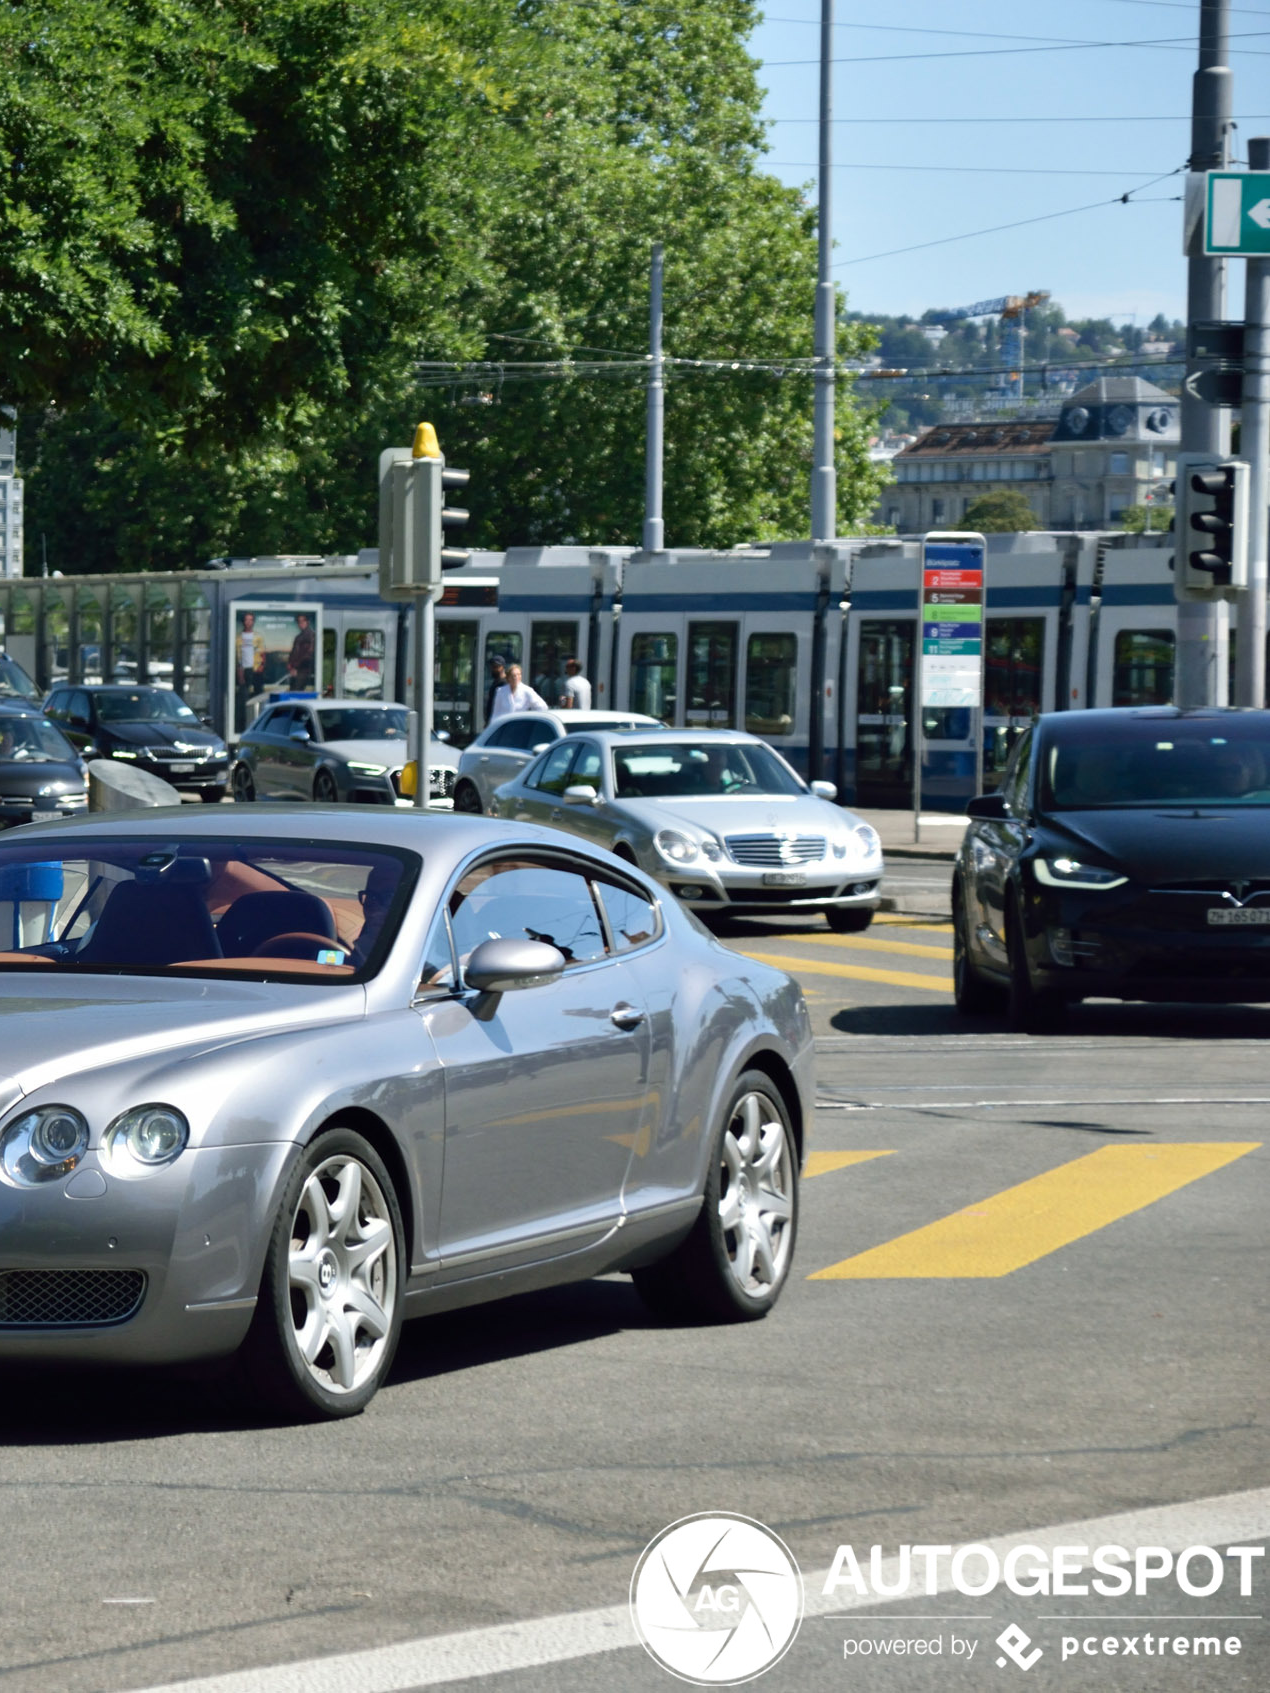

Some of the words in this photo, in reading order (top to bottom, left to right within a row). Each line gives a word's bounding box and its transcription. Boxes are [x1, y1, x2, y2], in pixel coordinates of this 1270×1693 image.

[932, 576, 939, 586] 2
[931, 627, 938, 637] 9
[928, 645, 938, 654] 11
